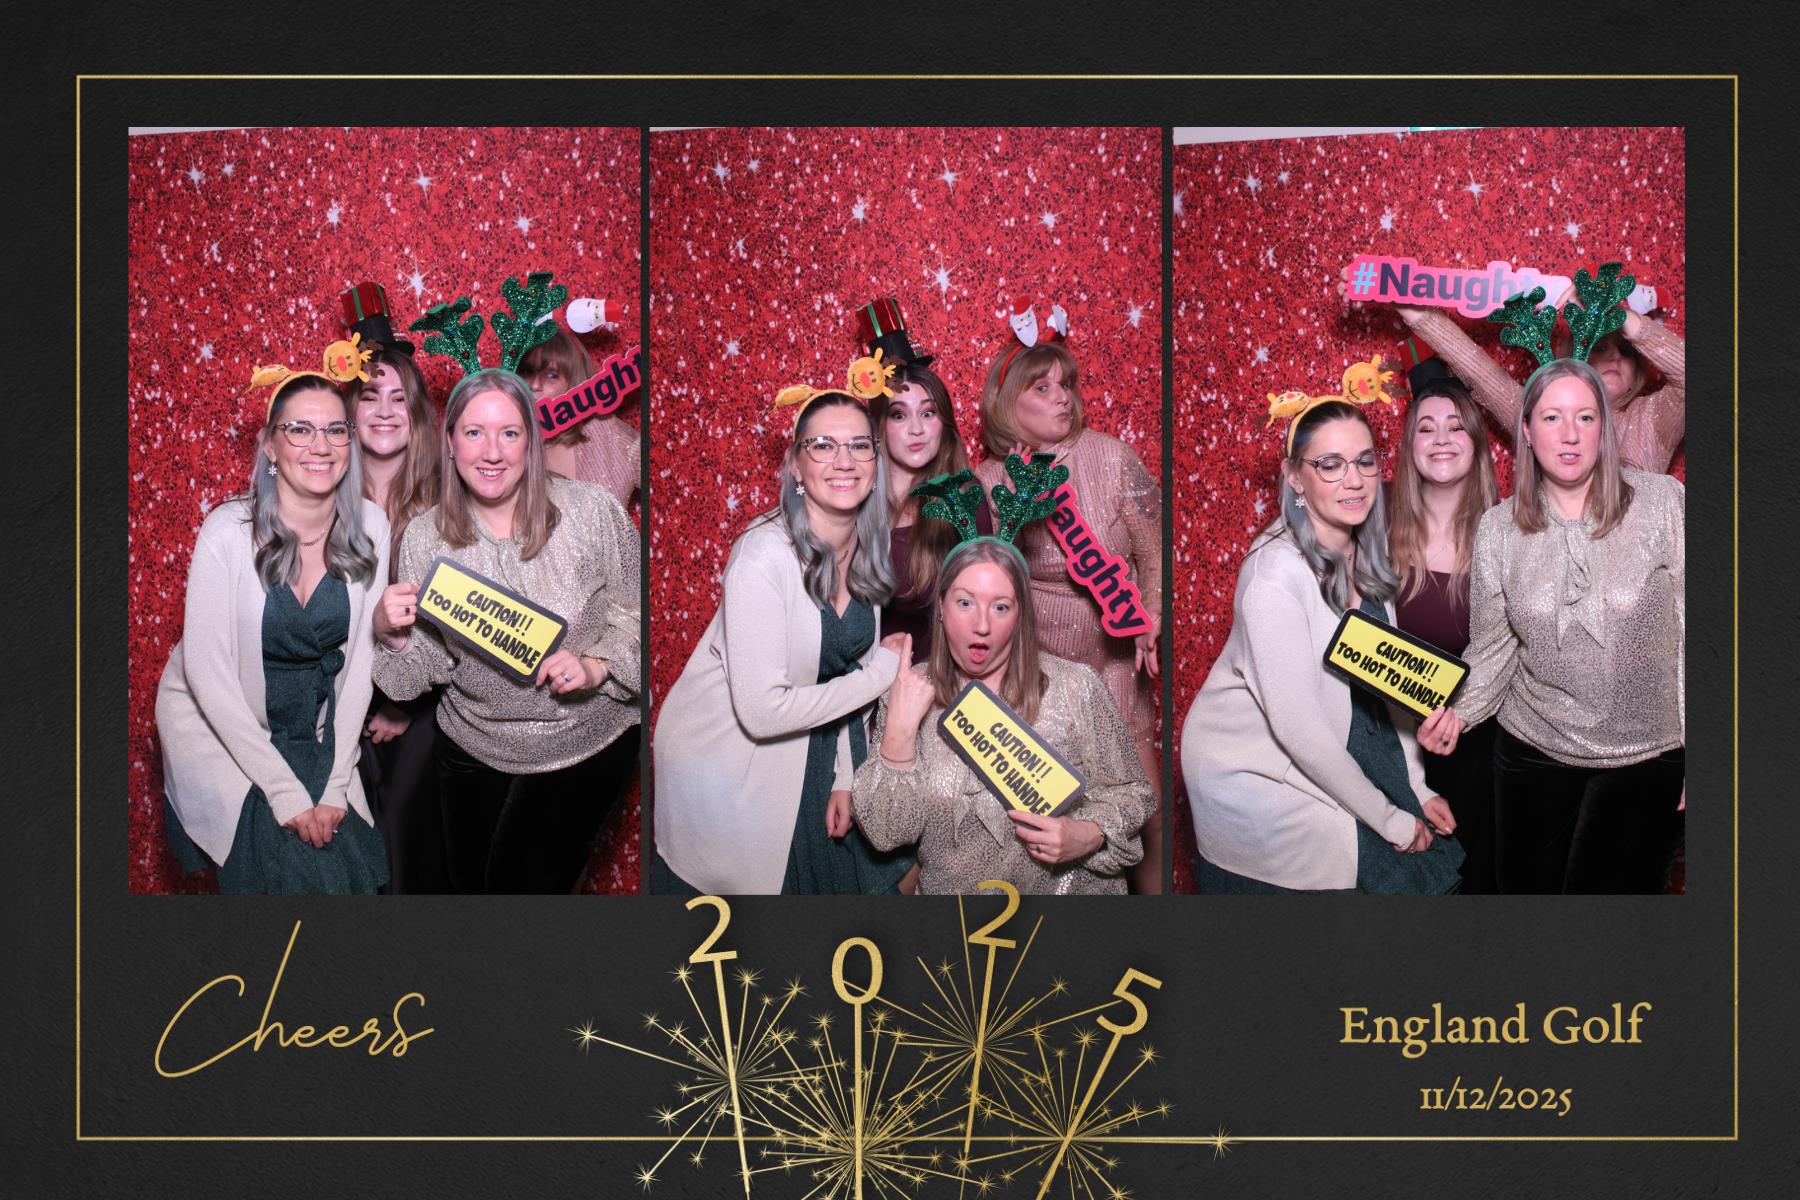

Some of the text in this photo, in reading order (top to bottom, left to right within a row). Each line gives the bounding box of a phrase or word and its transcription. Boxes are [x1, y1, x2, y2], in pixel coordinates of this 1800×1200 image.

[428, 588, 541, 669] TOO HOT TO HANDLE
[466, 590, 534, 637] CAUTION!!
[1336, 641, 1361, 664] TOO
[1359, 655, 1387, 678] HOT
[1386, 668, 1401, 687] TO
[1376, 641, 1439, 683] CAUTION!!
[951, 710, 975, 736] TOO
[970, 731, 997, 758] HOT
[990, 752, 1009, 774] TO
[990, 722, 1053, 784] CAUTION!!
